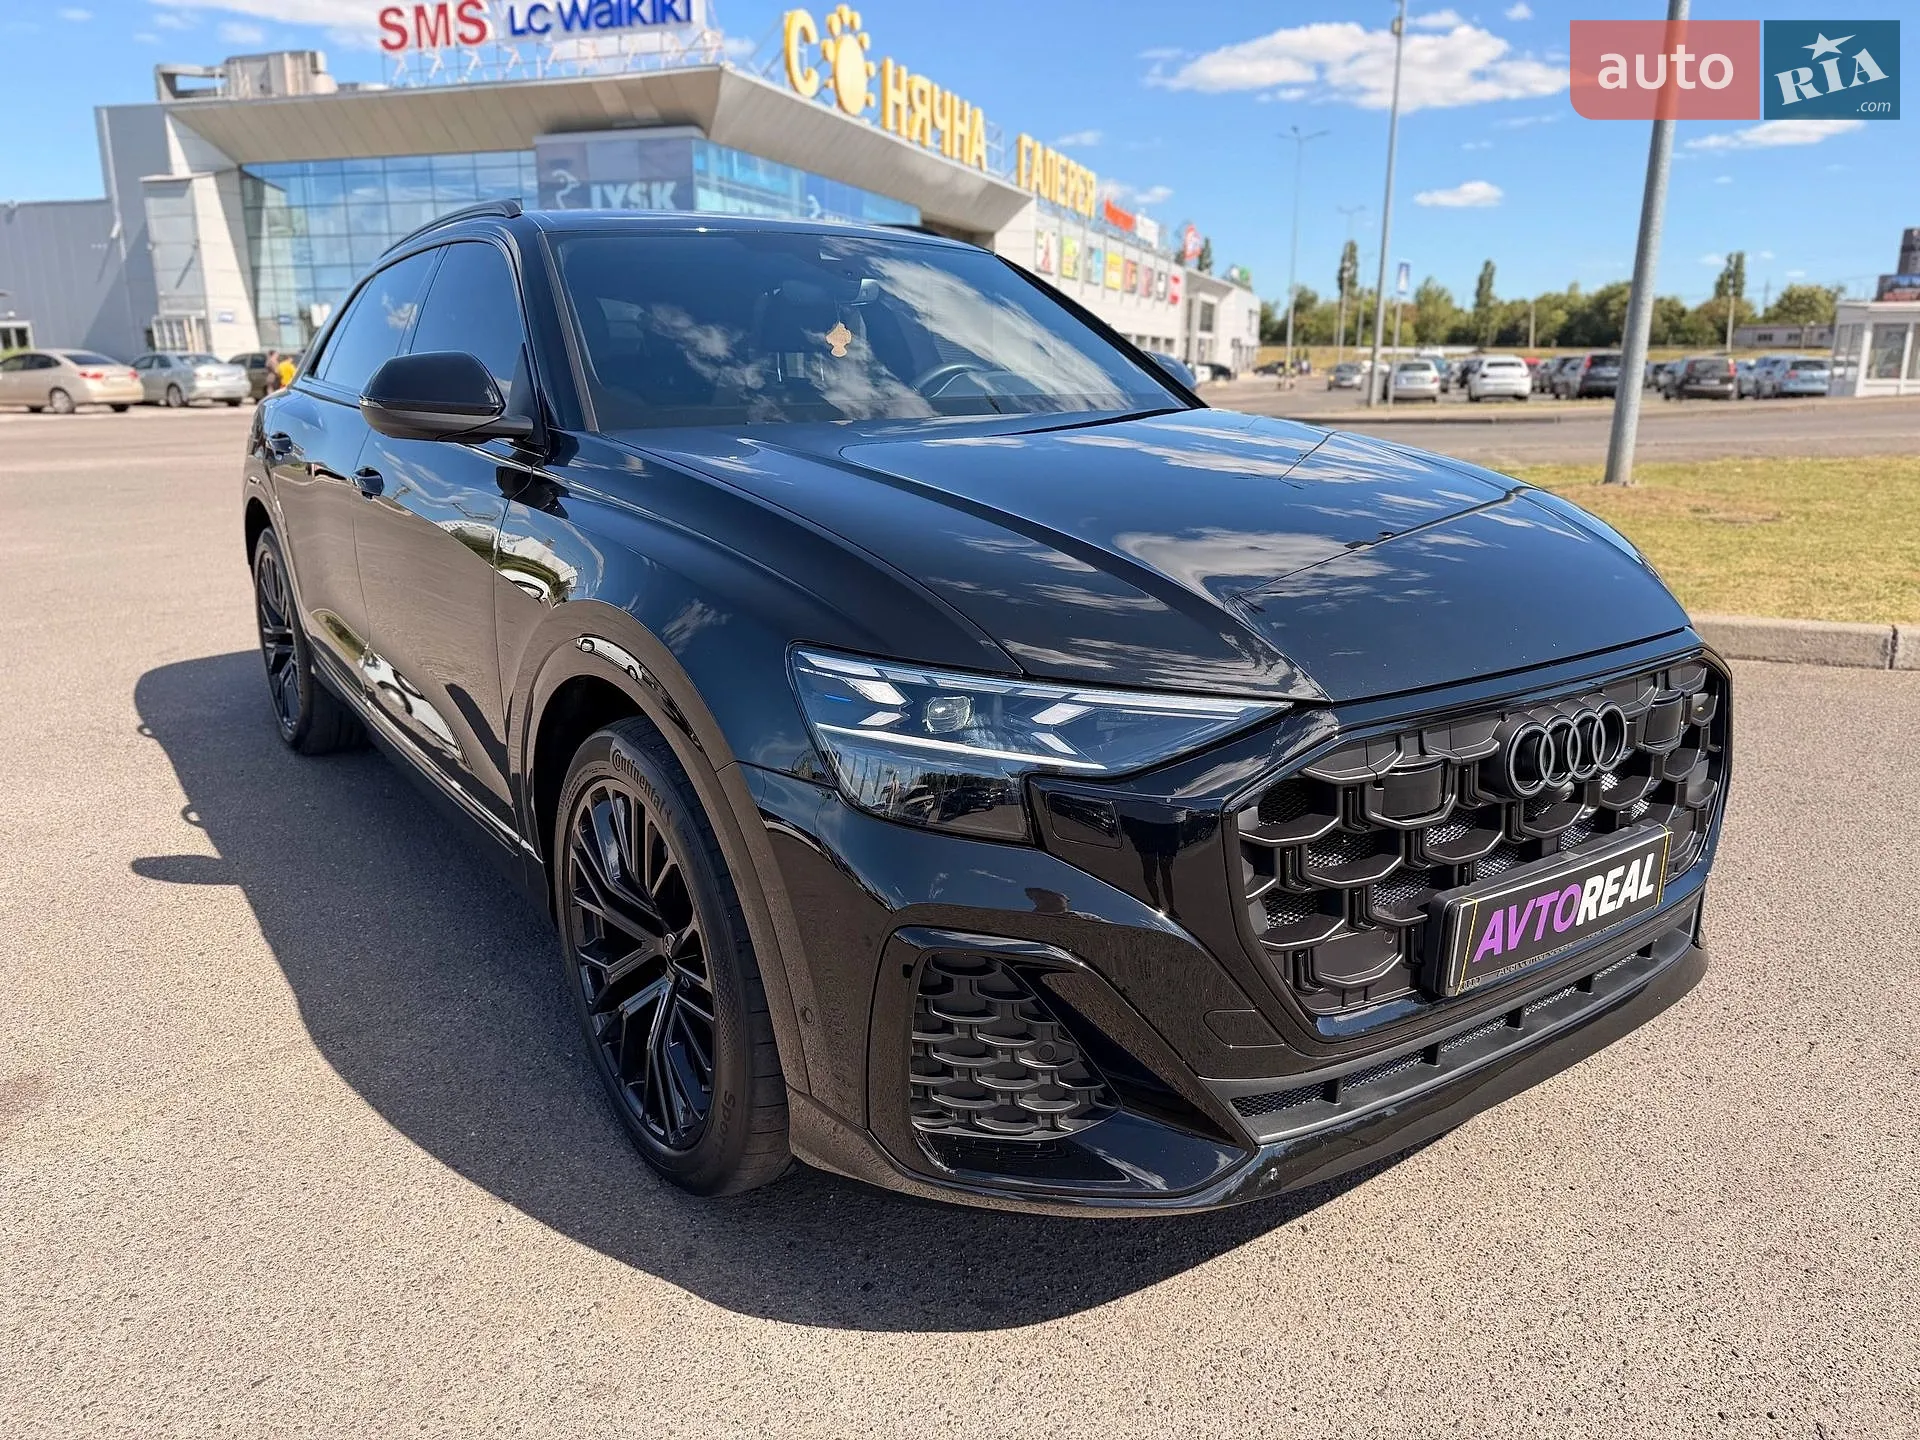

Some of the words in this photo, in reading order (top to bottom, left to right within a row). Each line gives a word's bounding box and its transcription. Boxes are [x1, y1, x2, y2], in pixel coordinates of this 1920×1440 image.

[378, 0, 488, 51] SMS
[1016, 132, 1097, 218] ГАЛЕРЕЯ
[611, 749, 665, 816] Continental
[1473, 853, 1655, 962] AVTOREAL
